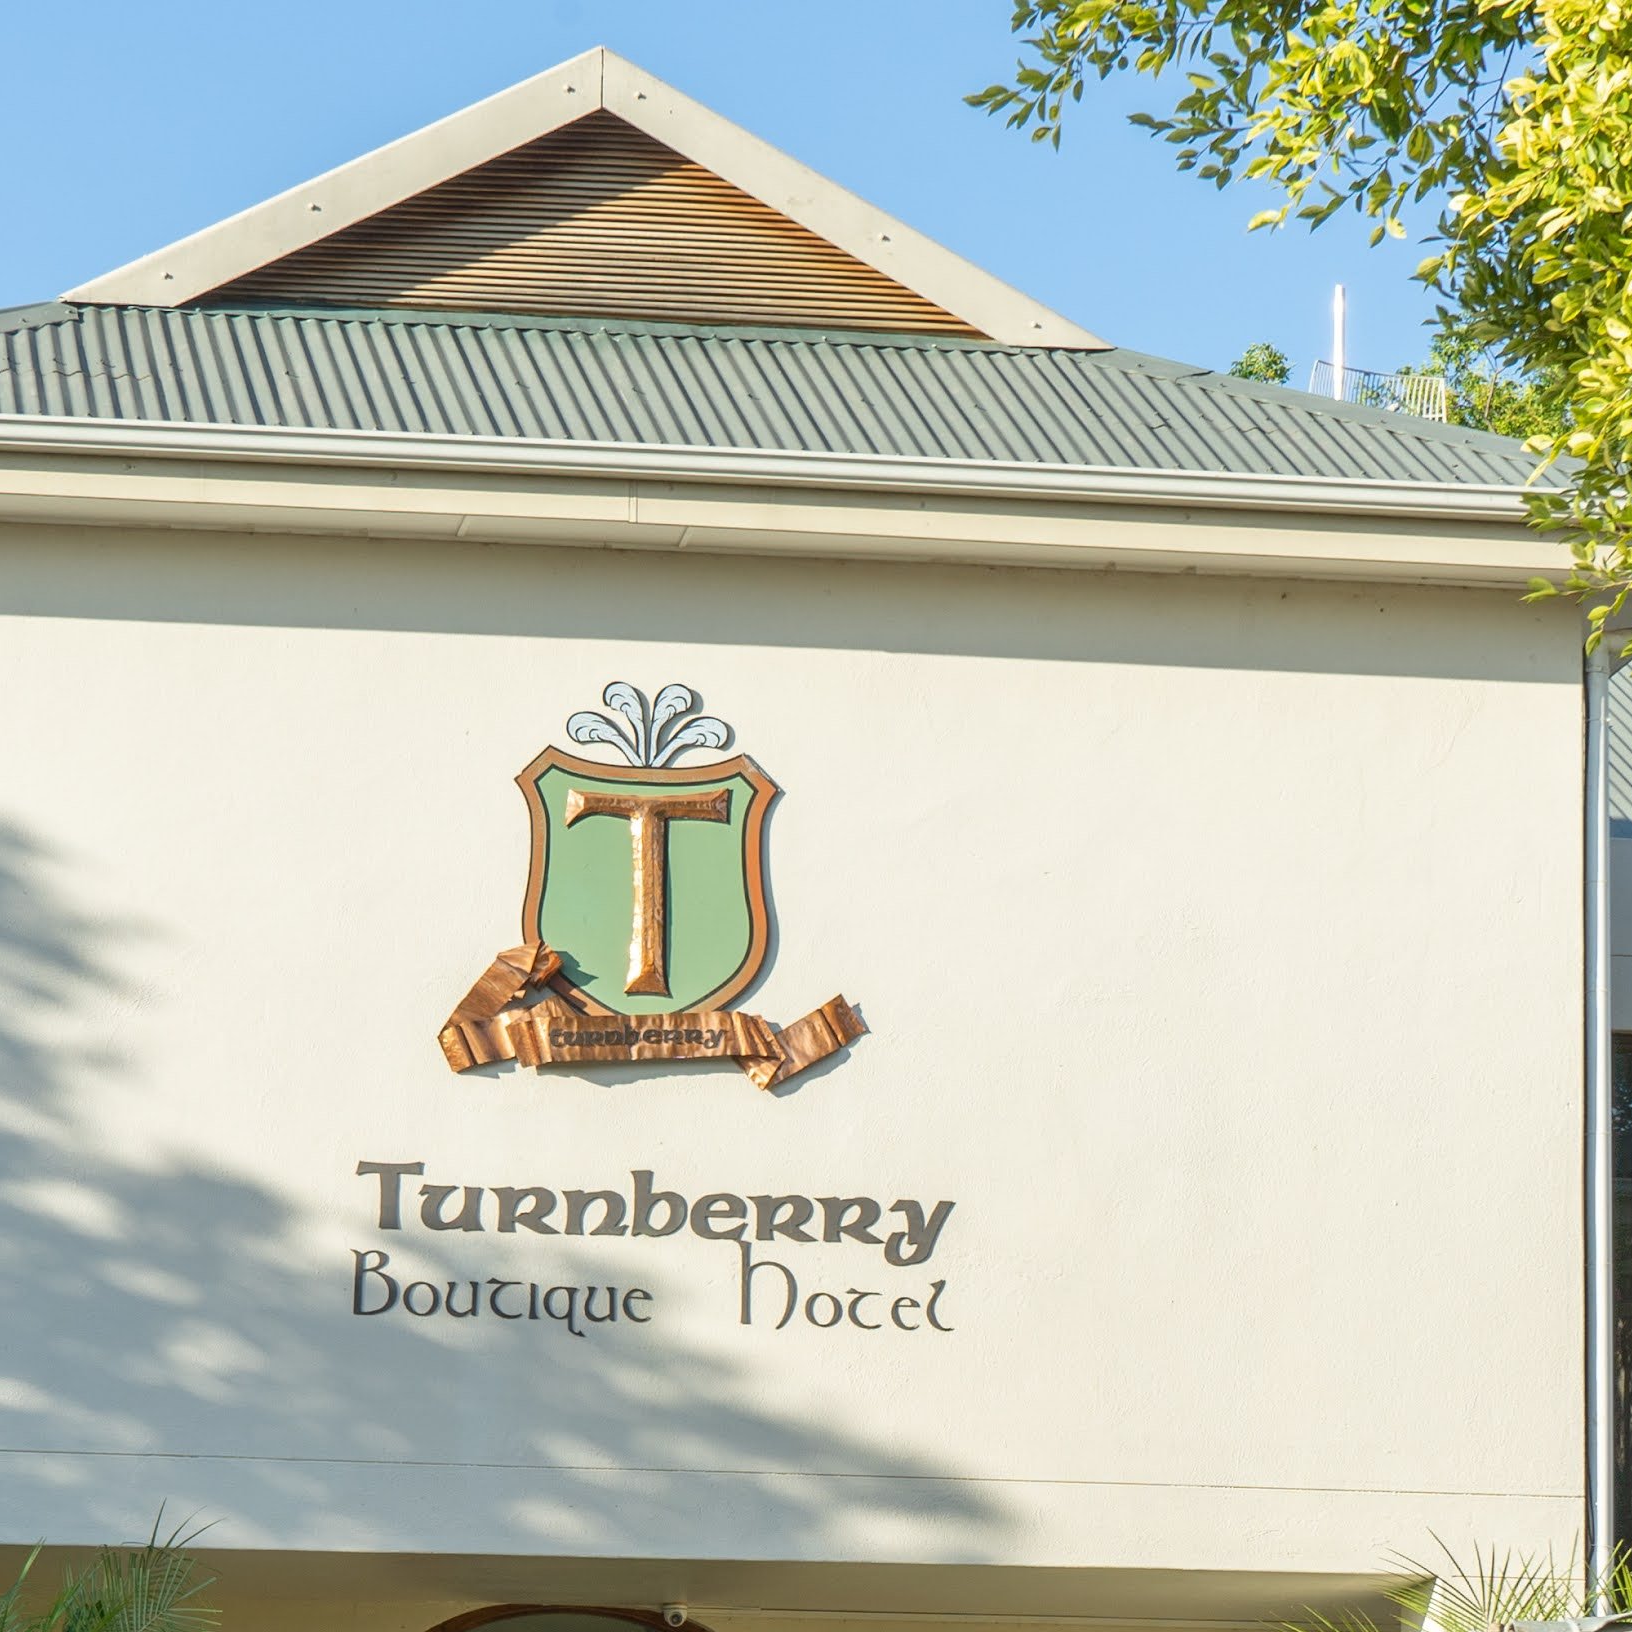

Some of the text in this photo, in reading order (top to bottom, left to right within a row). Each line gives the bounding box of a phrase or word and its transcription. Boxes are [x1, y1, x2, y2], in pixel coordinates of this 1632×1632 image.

[565, 787, 731, 998] T
[355, 1159, 957, 1267] Turnberry
[349, 1248, 654, 1338] Boutique
